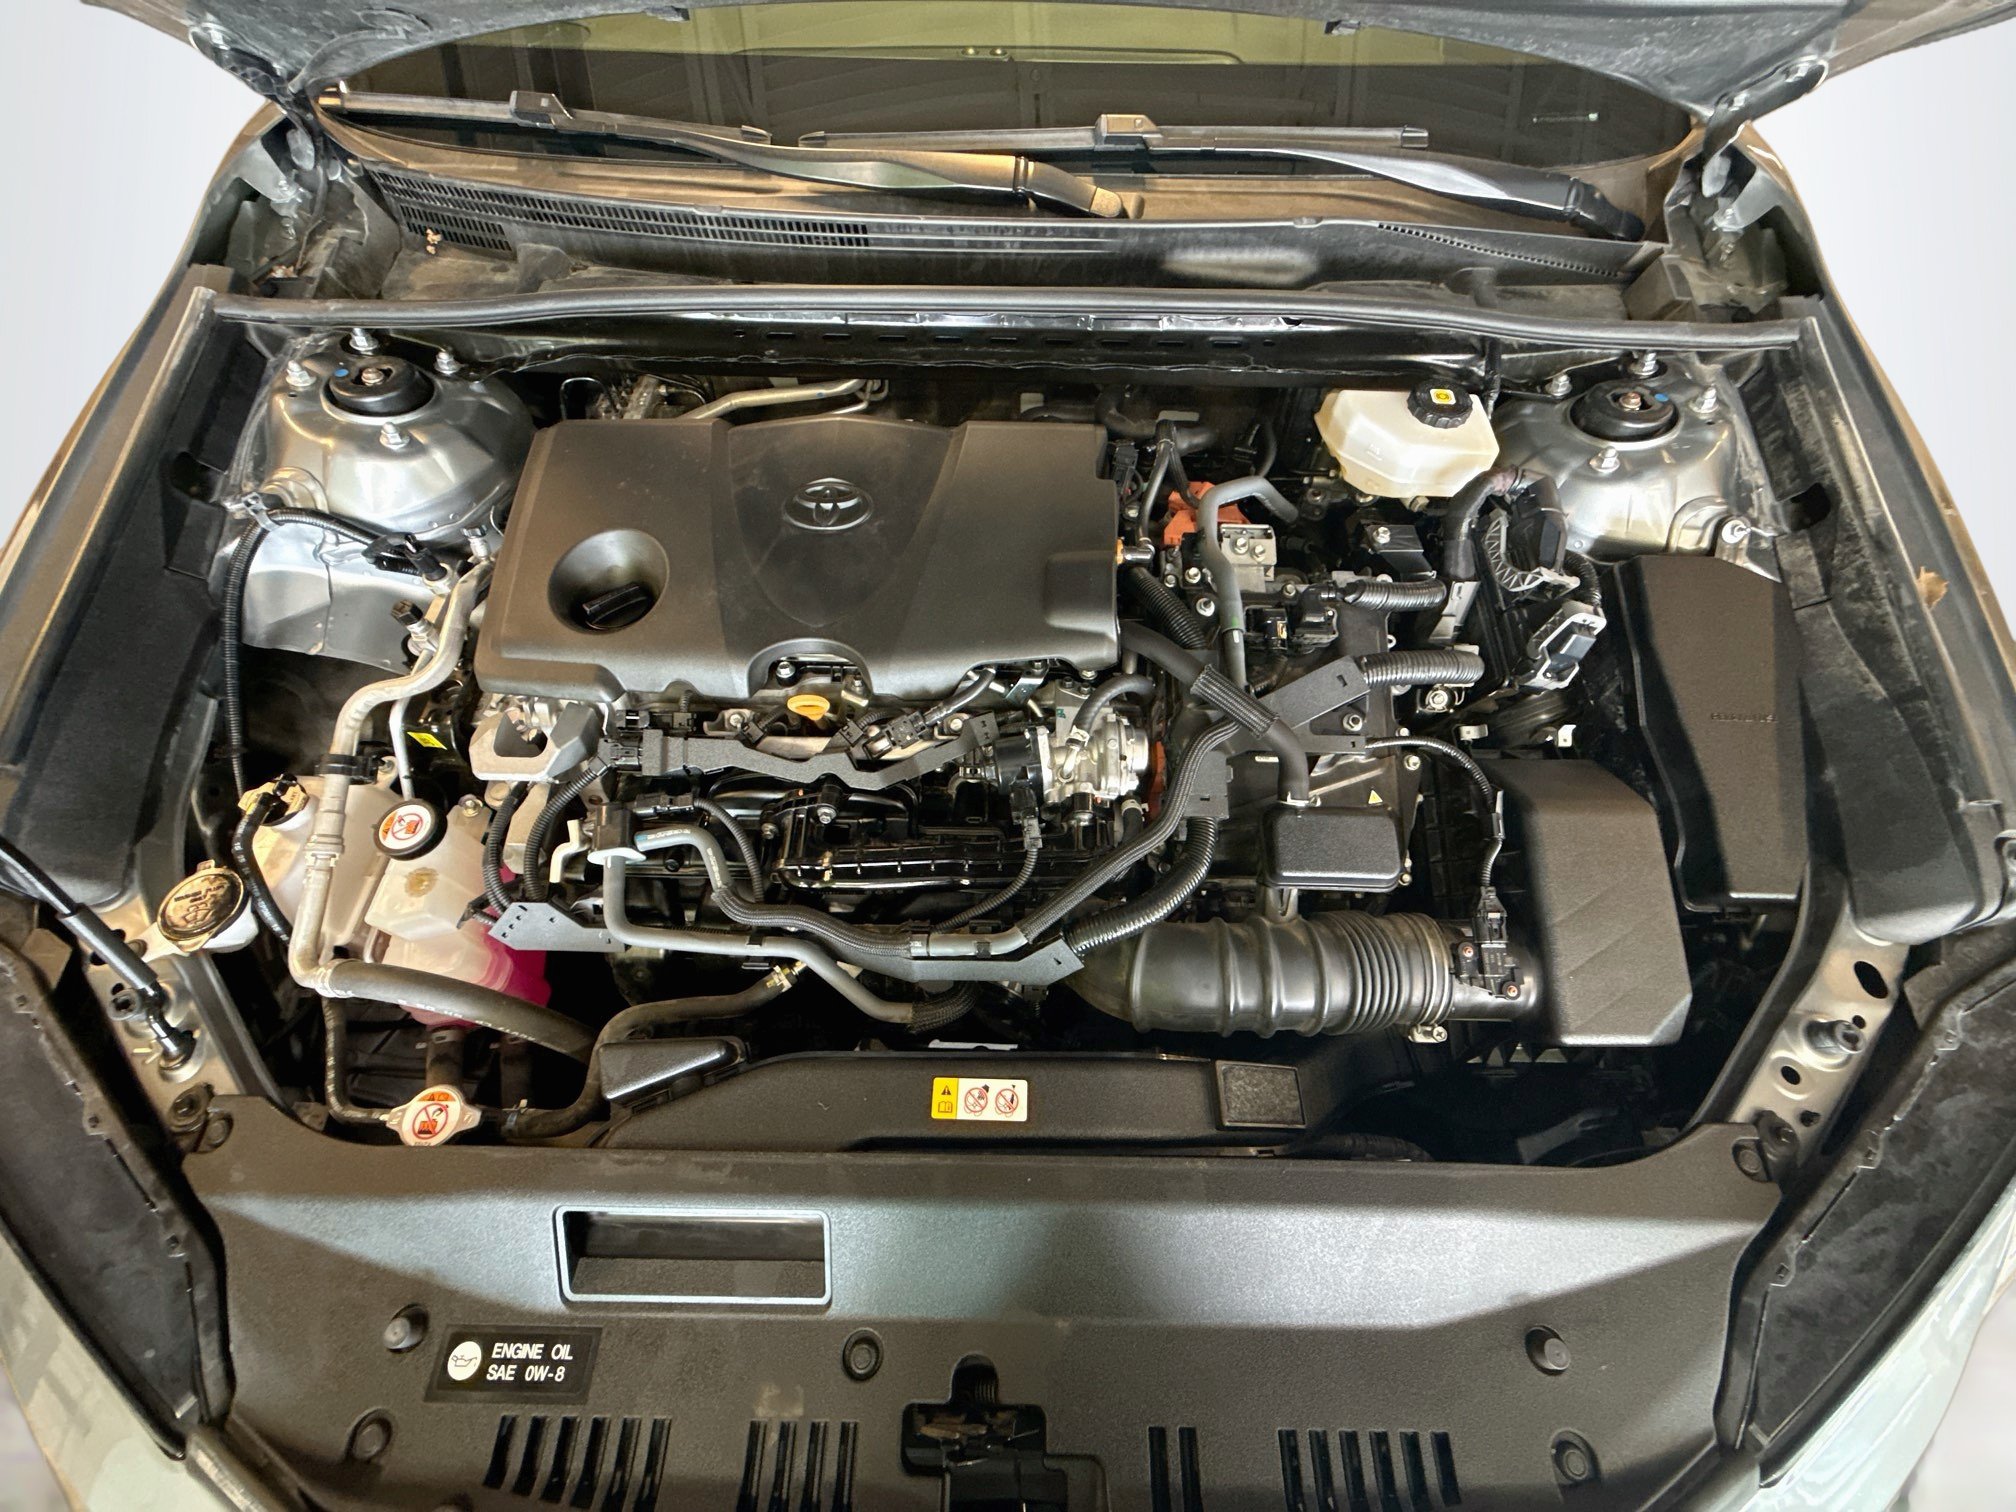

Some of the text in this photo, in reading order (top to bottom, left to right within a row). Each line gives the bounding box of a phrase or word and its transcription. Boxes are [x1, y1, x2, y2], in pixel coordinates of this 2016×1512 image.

[491, 1342, 573, 1360] ENGINE OIL
[486, 1364, 566, 1382] SAE 0W-8
